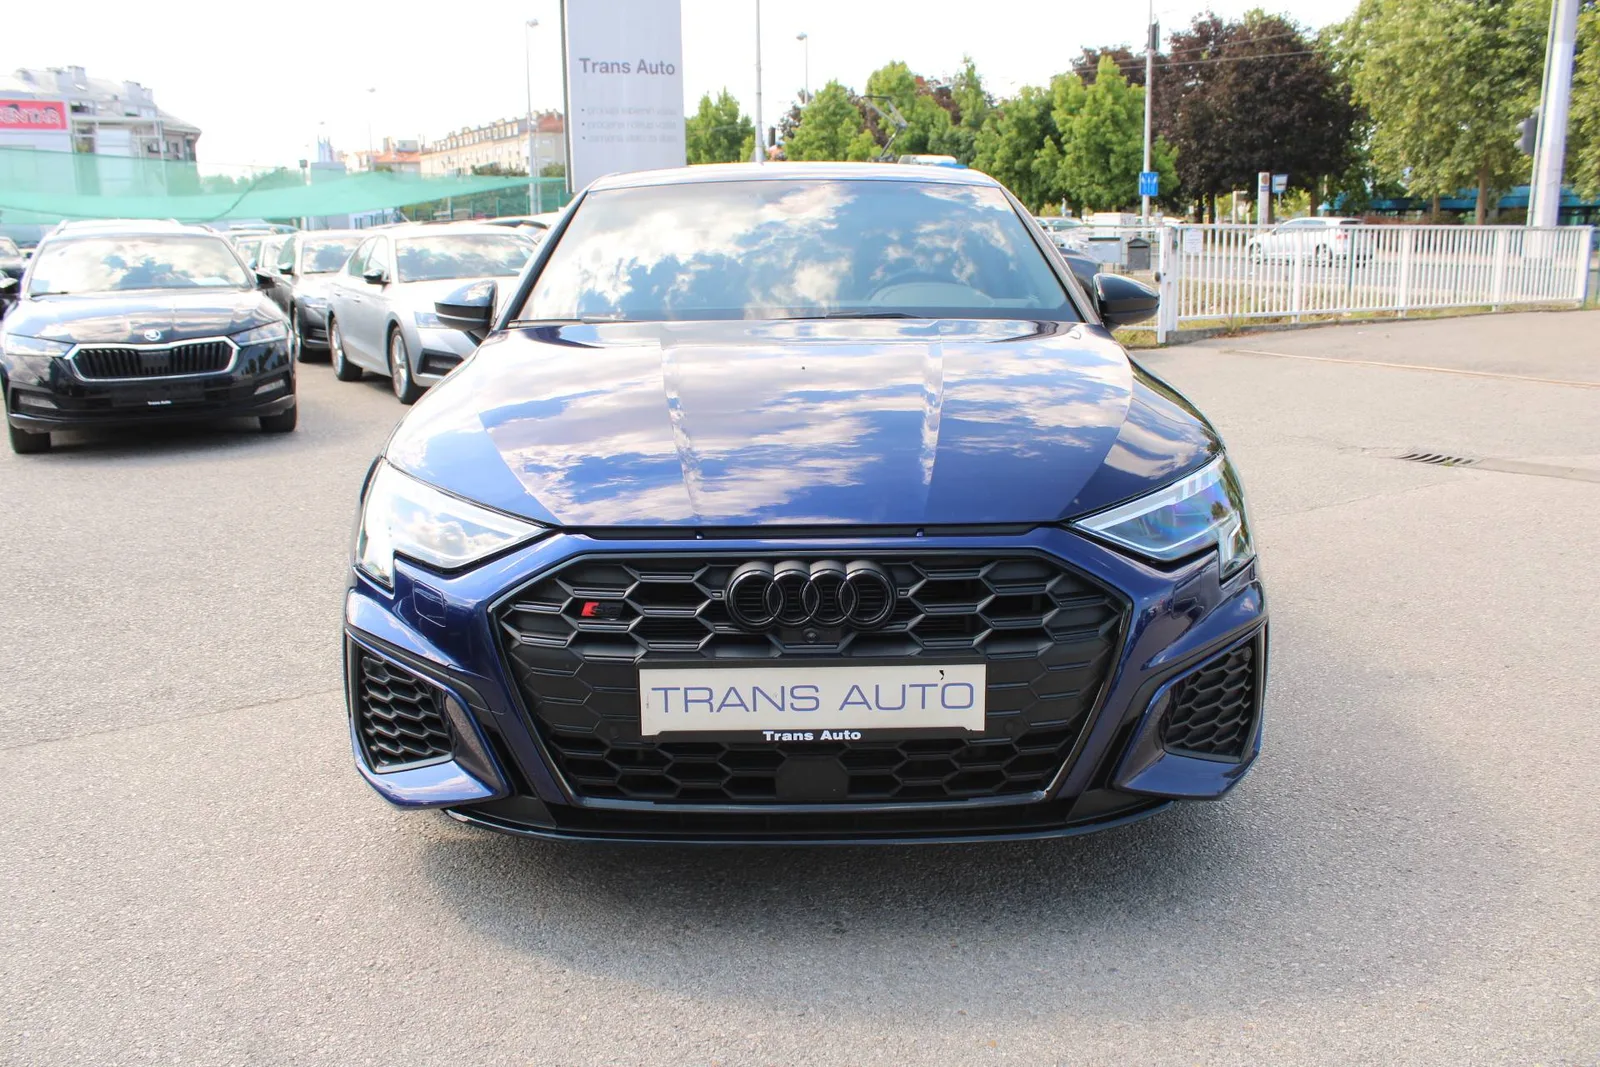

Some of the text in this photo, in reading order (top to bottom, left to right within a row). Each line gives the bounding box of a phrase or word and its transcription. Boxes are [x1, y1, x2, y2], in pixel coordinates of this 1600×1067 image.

[579, 57, 675, 75] Trans Auto
[651, 682, 975, 713] TRANS AUTO
[762, 729, 862, 741] Trans Auto
